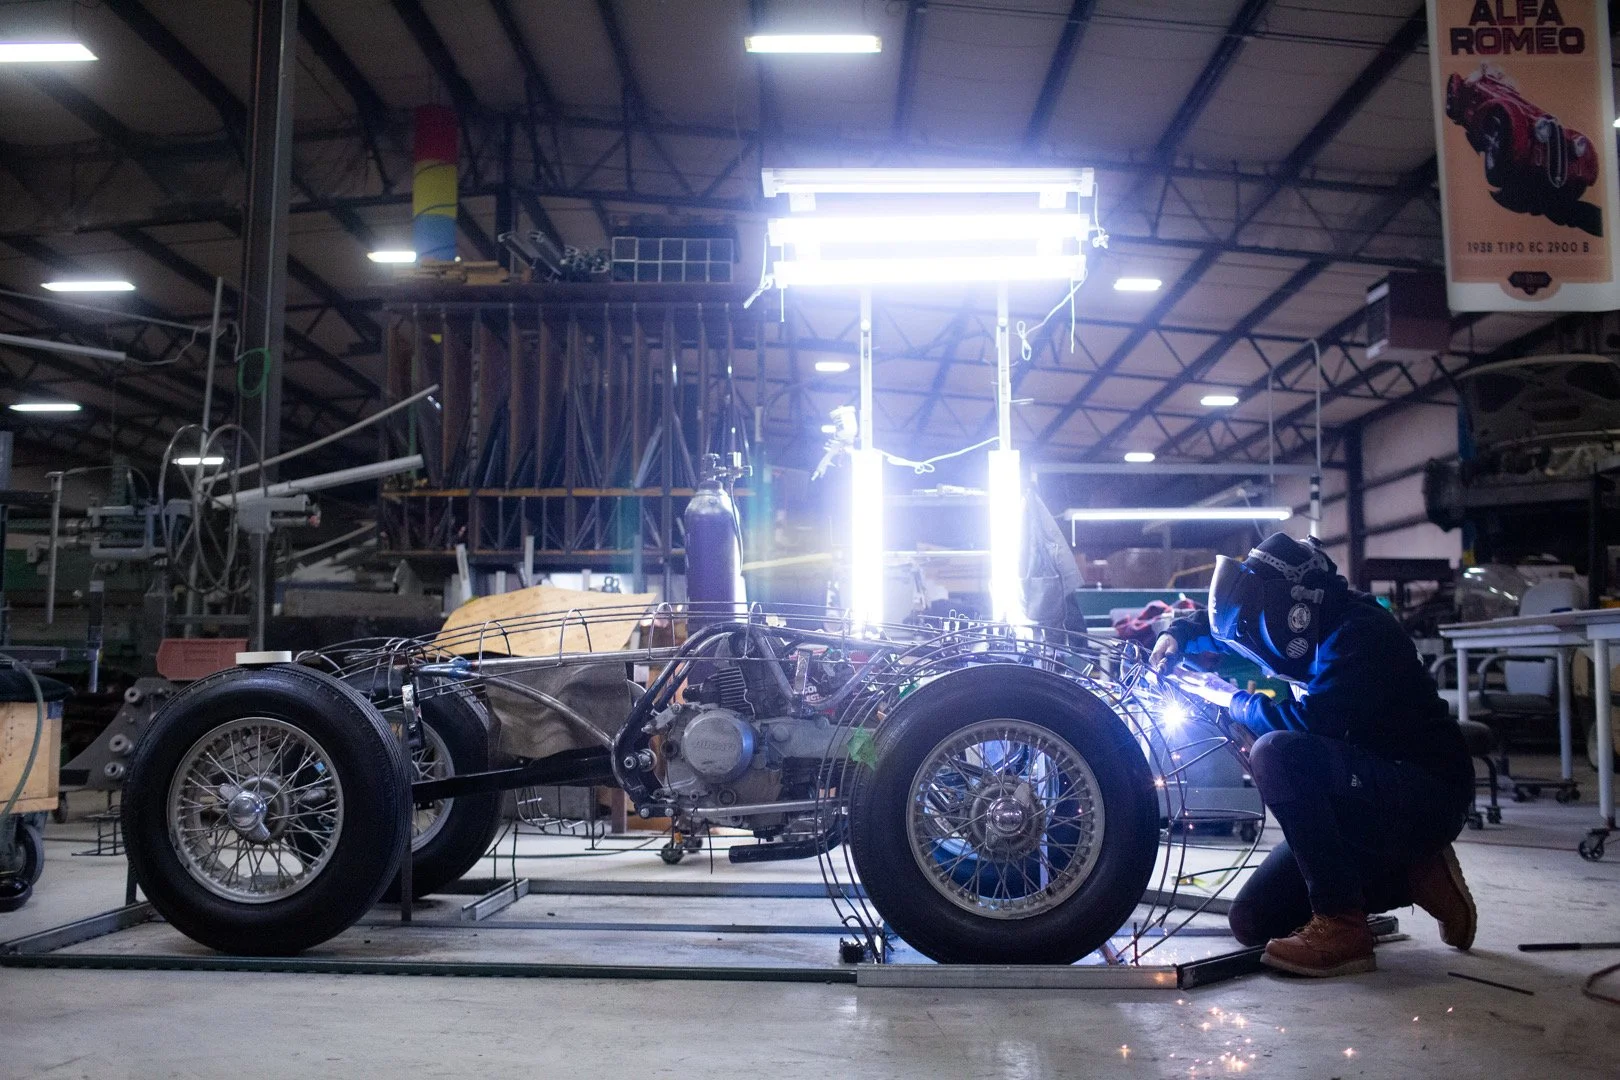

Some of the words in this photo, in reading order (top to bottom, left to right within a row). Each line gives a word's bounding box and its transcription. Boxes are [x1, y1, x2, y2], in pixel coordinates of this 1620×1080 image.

[1468, 0, 1565, 26] ALFA
[1450, 27, 1586, 55] ROMEO
[1467, 242, 1493, 253] 1938
[1498, 242, 1524, 253] TIPO
[1529, 242, 1544, 253] 8C
[1548, 242, 1578, 253] 2900
[1583, 242, 1589, 253] B
